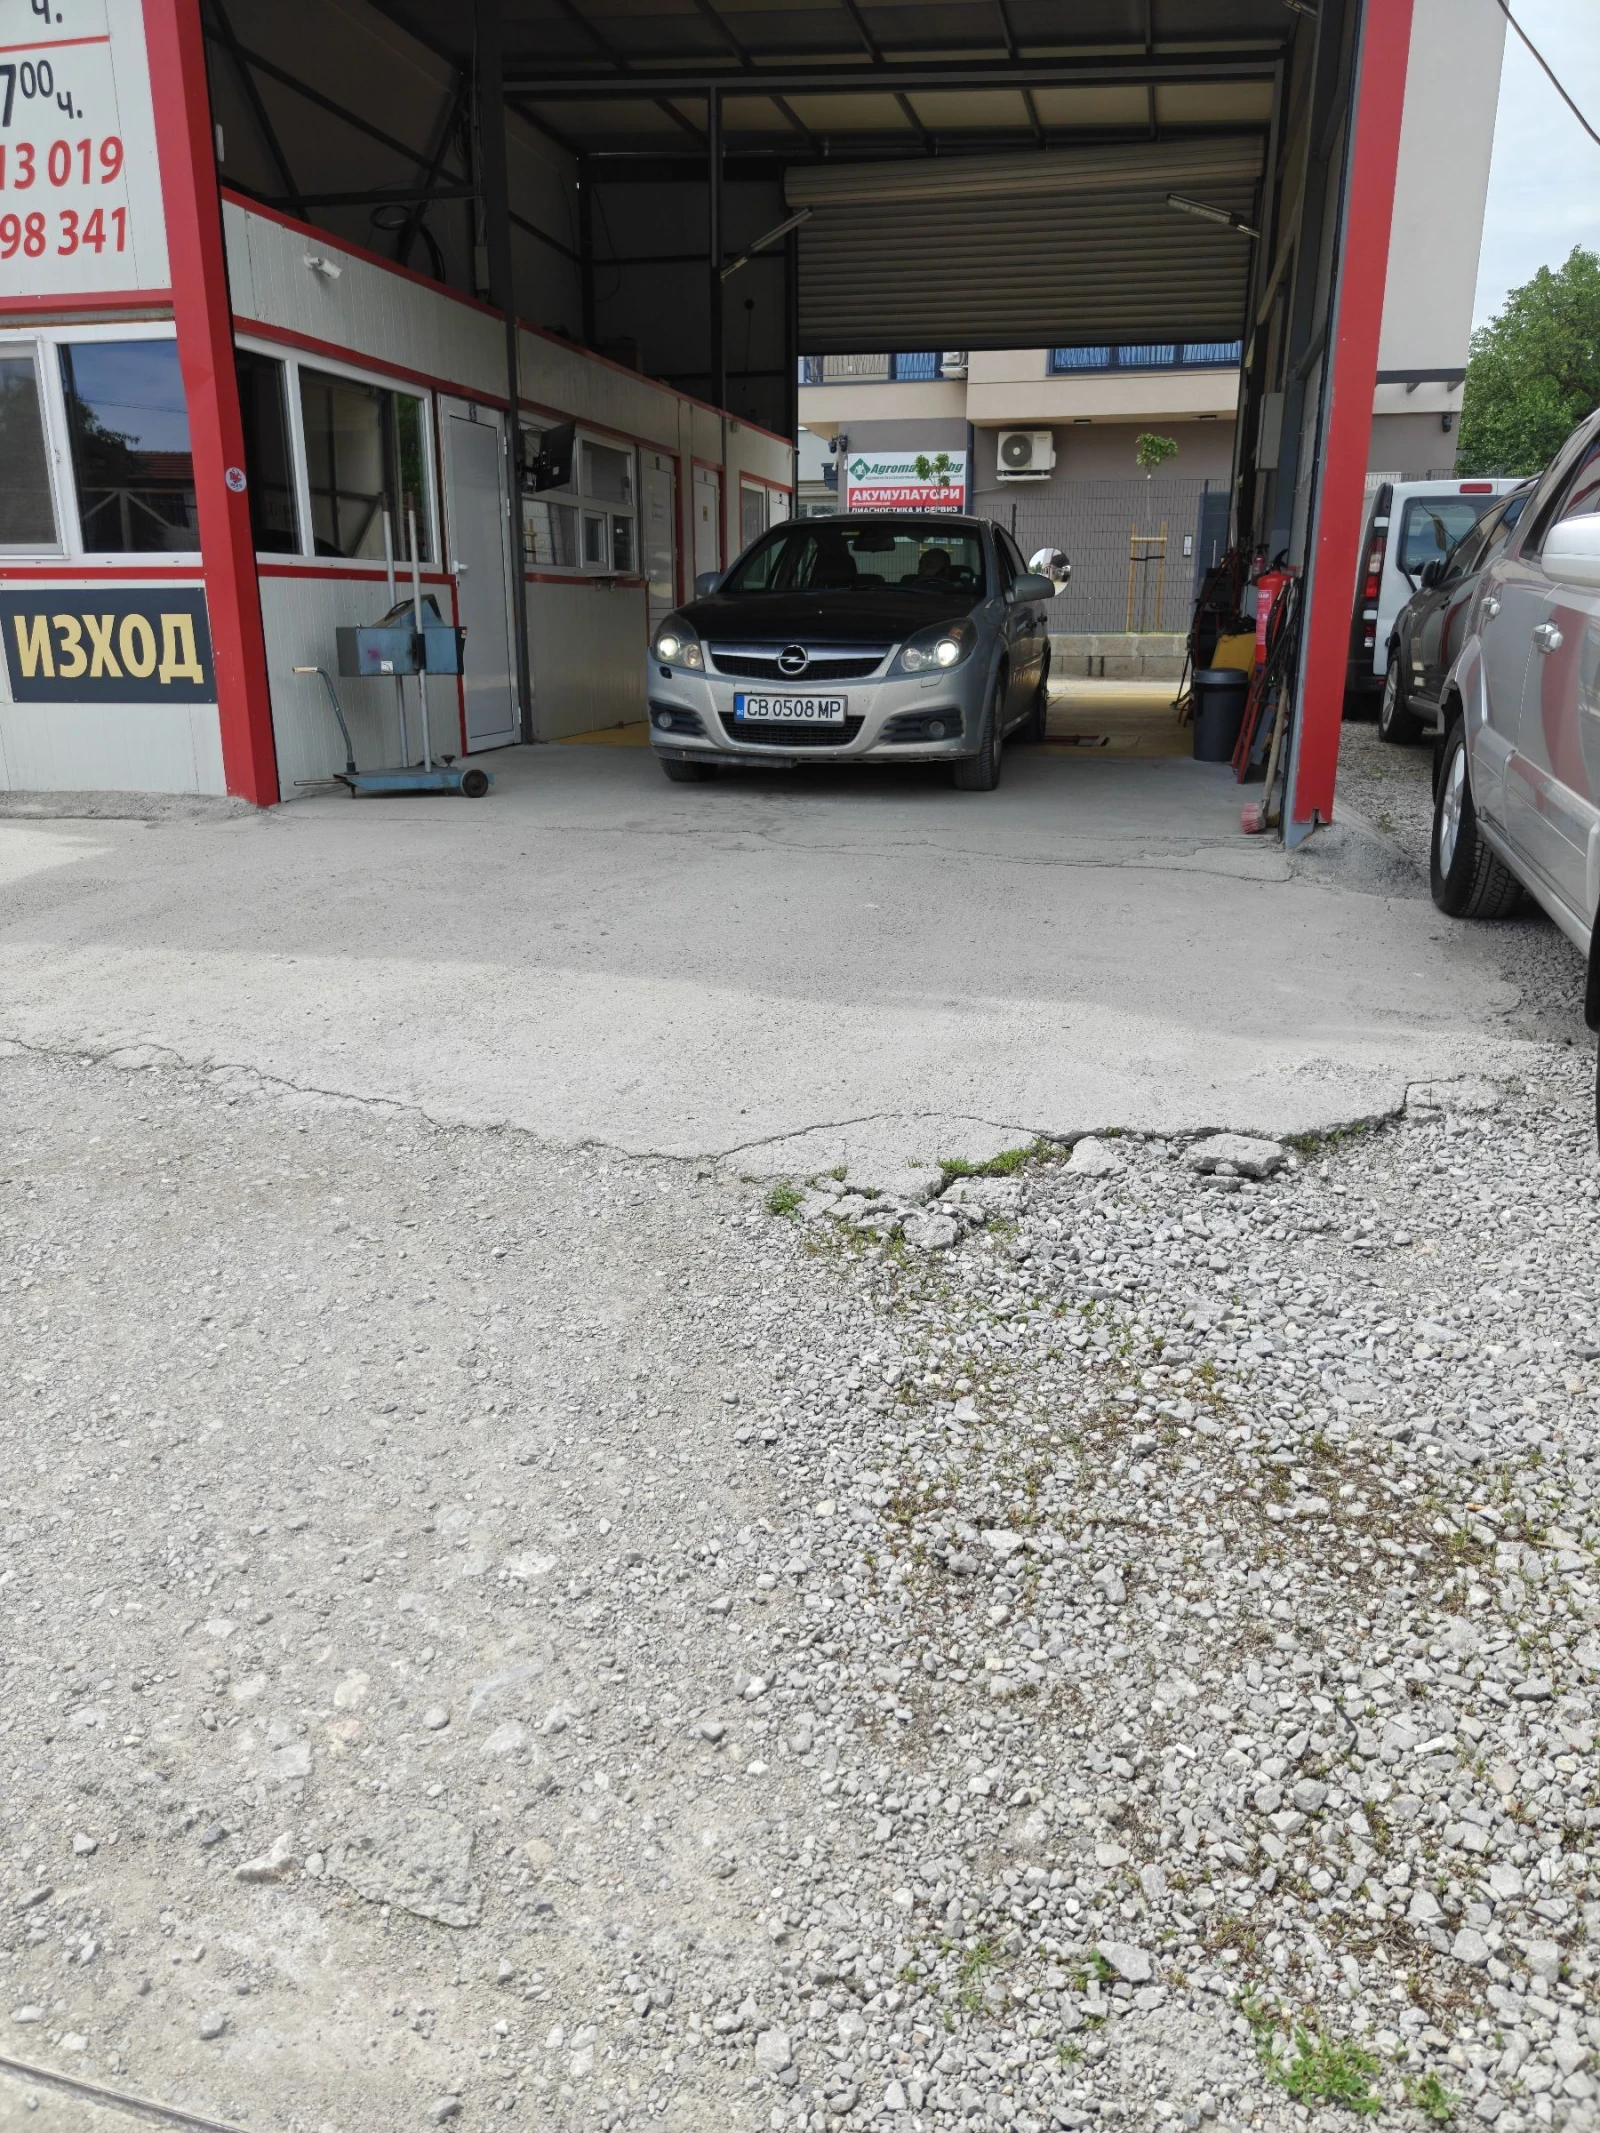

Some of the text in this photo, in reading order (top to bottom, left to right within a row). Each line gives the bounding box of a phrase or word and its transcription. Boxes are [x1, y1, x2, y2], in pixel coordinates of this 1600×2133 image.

[48, 136, 124, 187] 019
[0, 206, 126, 260] 98 341
[852, 489, 960, 501] АКУМУЛАТОРИ
[13, 613, 205, 684] ИЗХОД
[747, 699, 841, 719] CB 0508 MP
